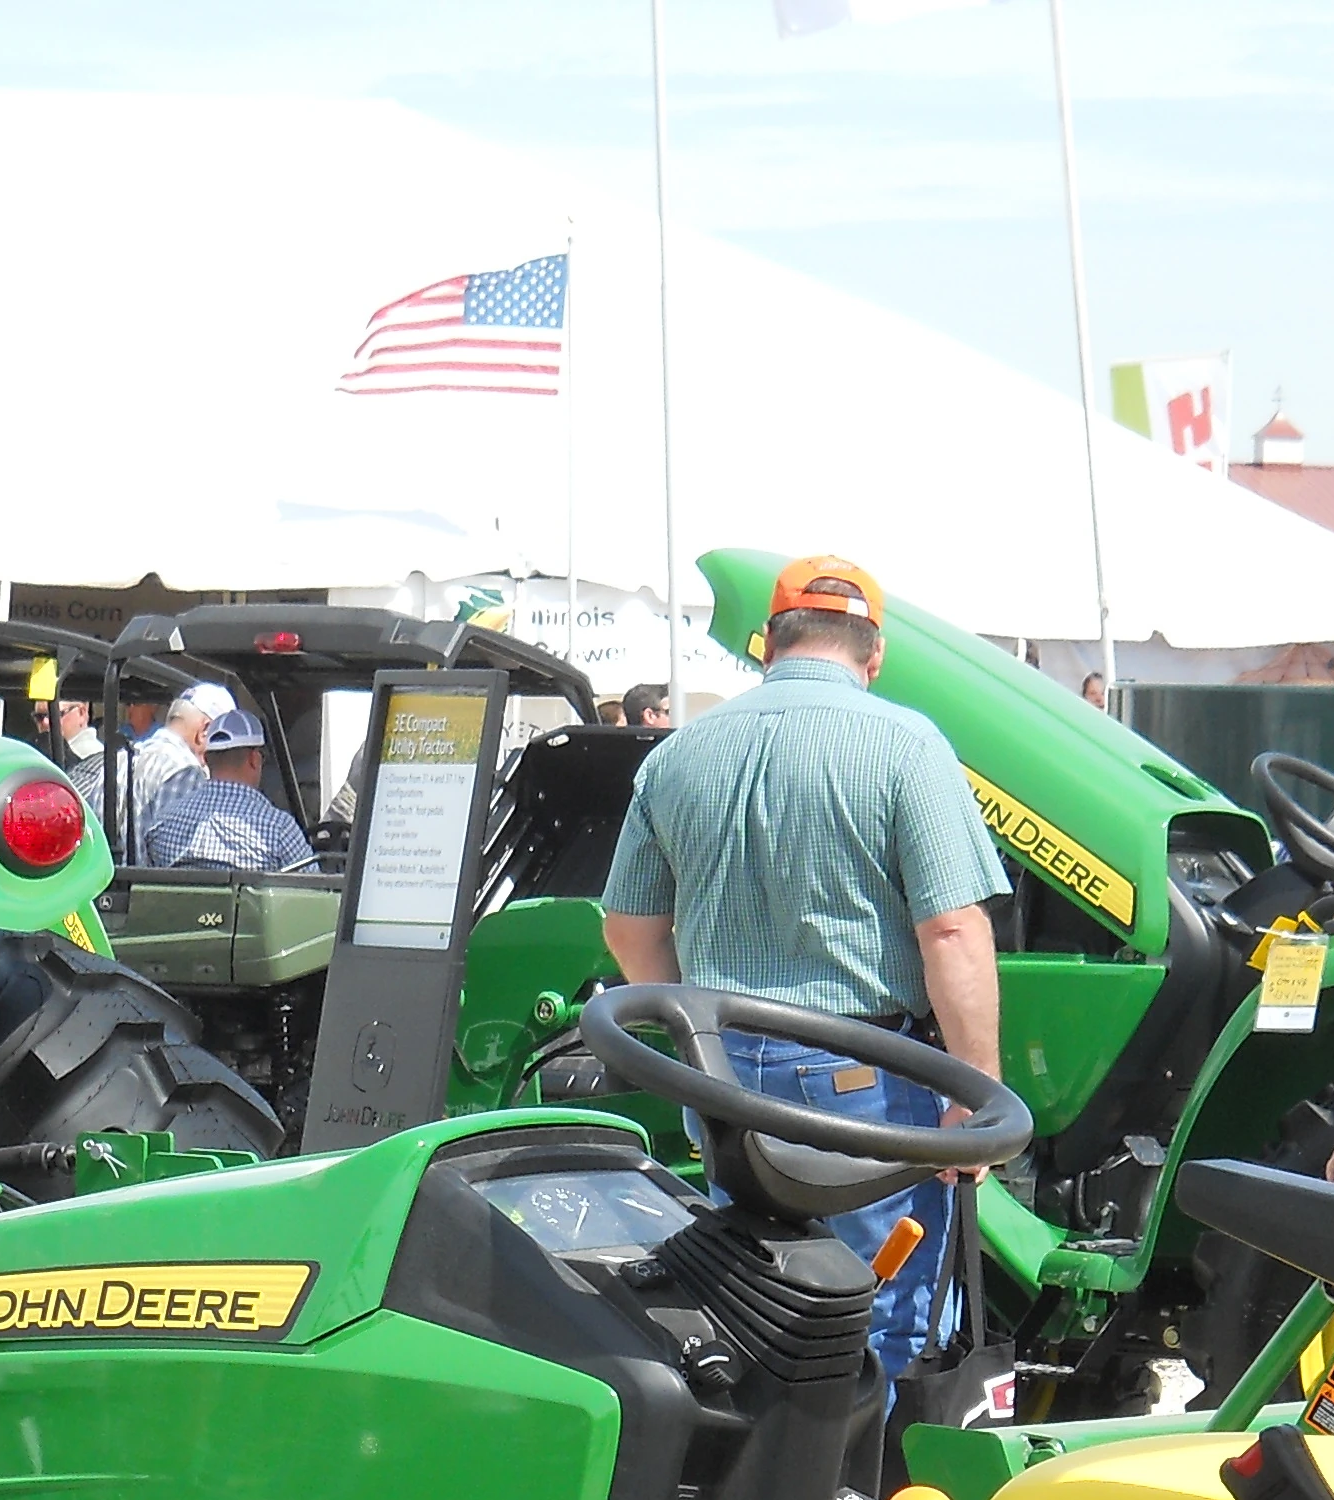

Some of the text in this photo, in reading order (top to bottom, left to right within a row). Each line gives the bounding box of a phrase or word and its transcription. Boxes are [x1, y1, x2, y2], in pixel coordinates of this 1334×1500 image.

[67, 600, 123, 622] Corn
[407, 713, 449, 734] Compact
[389, 736, 456, 760] Utility Tractors
[1011, 817, 1110, 902] DEERE
[197, 911, 224, 927] 4X4
[94, 1279, 261, 1325] DEERE
